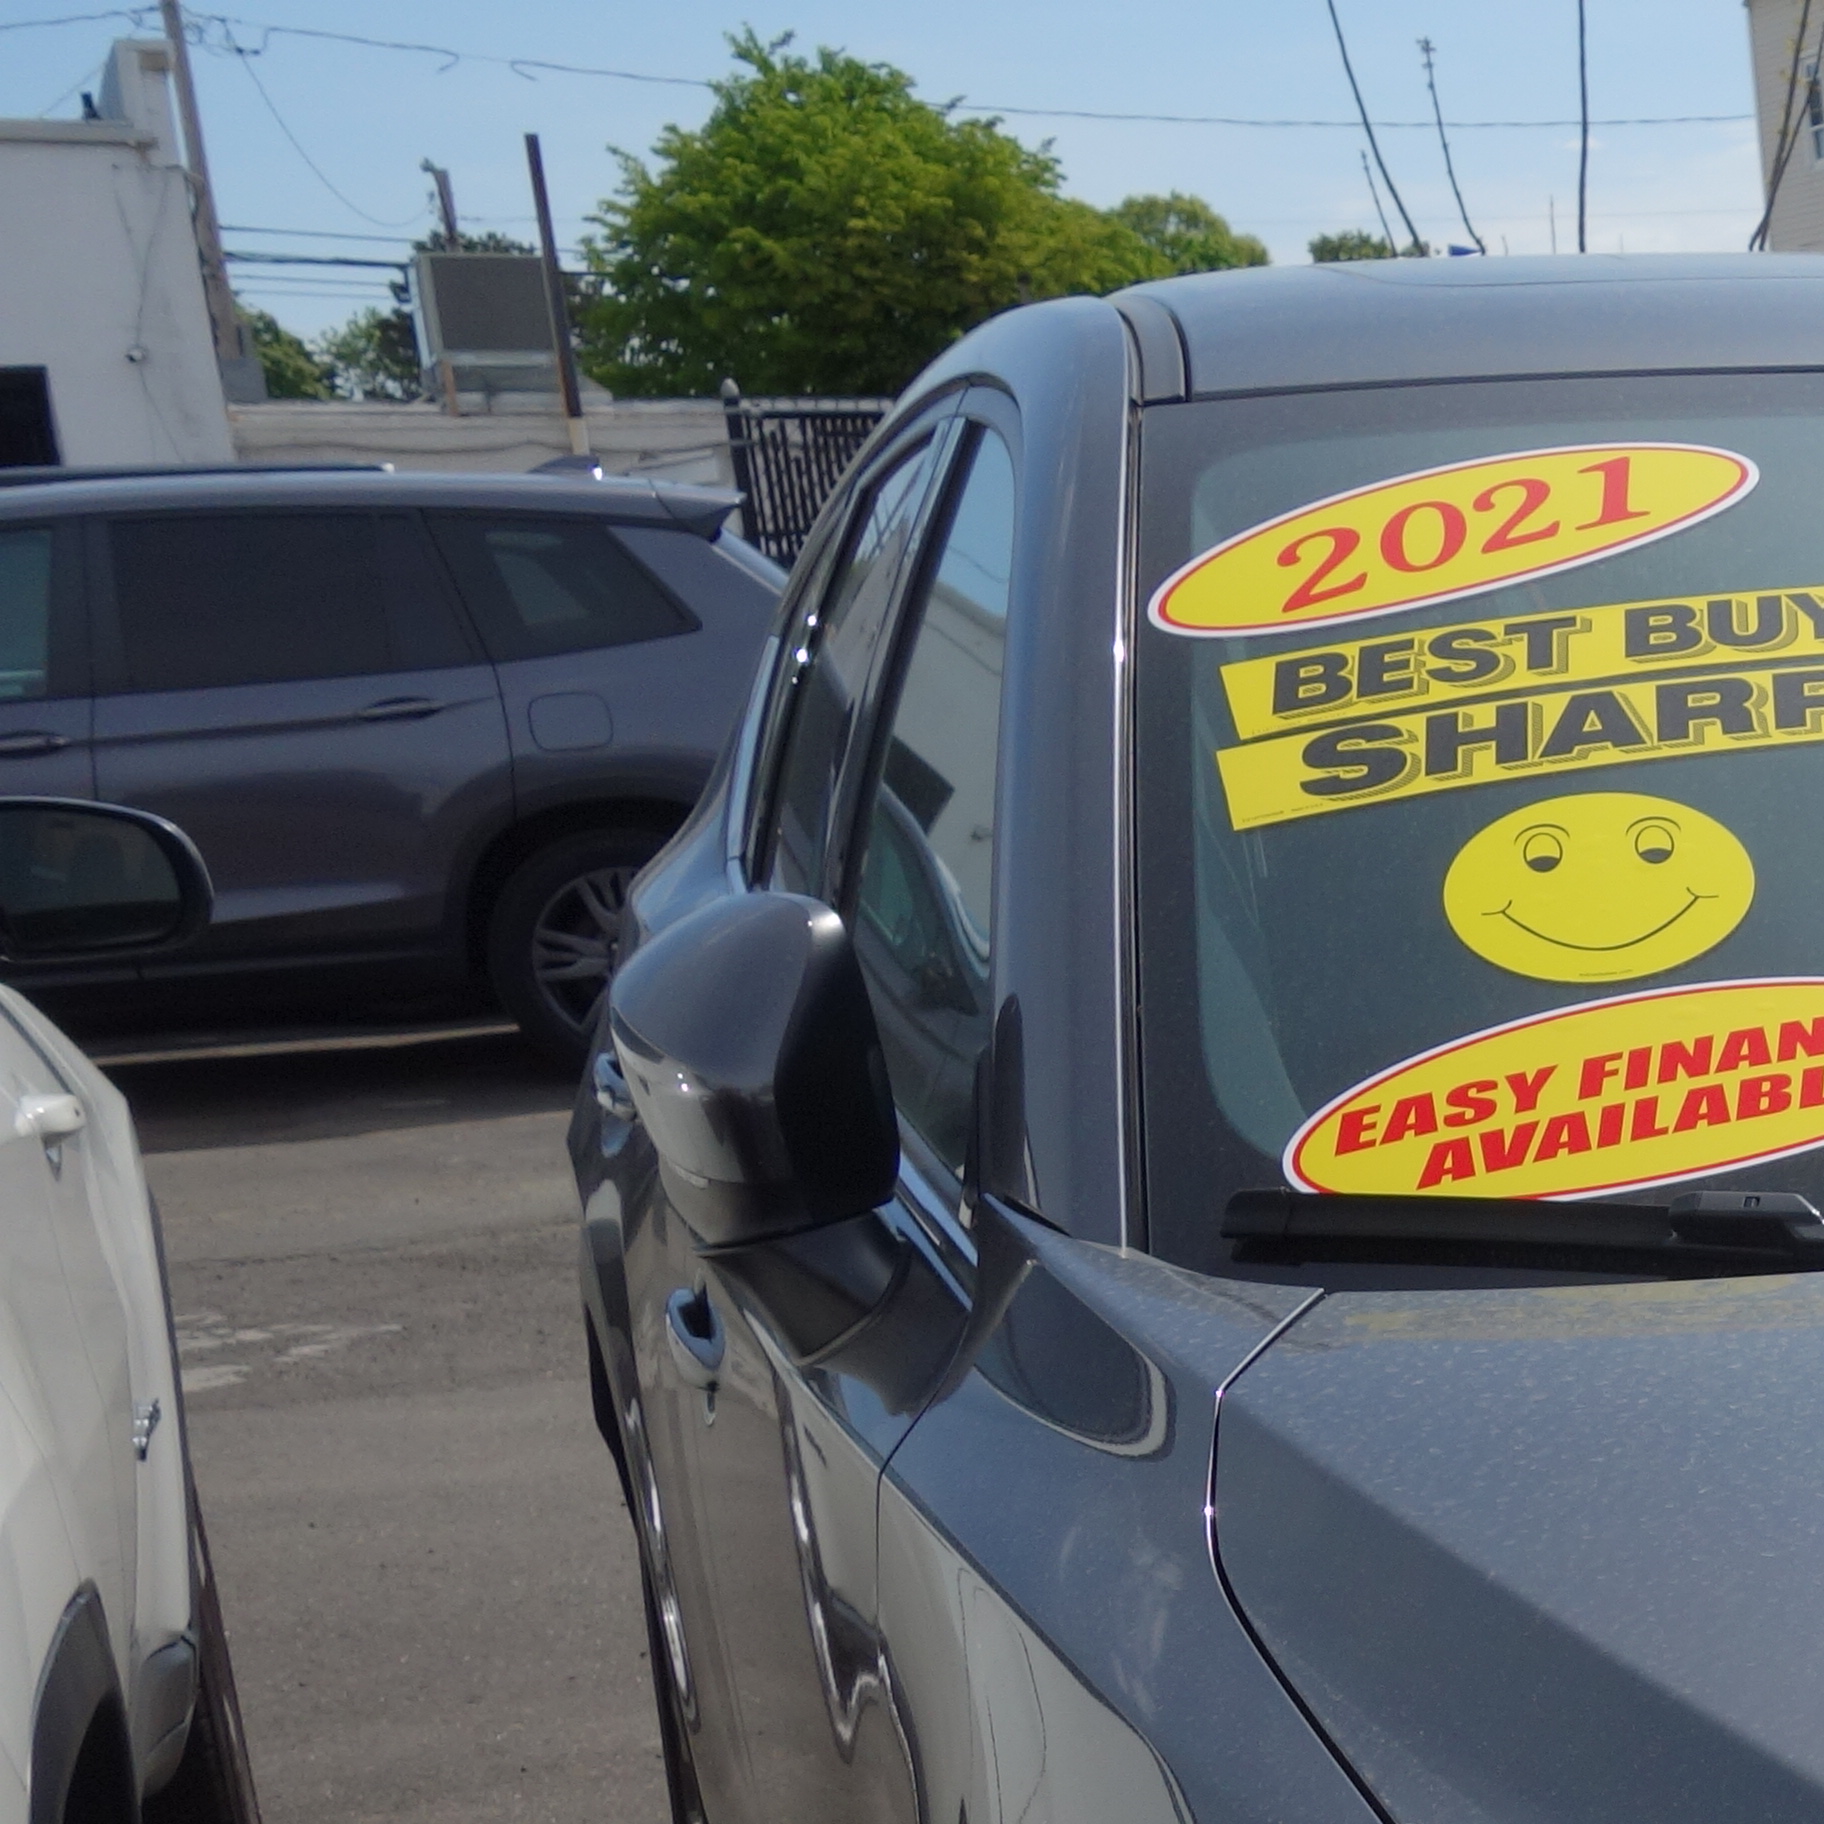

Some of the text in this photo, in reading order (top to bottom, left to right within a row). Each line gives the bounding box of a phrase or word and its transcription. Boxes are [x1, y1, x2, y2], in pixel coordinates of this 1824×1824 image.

[1277, 455, 1651, 612] 2021
[1271, 614, 1591, 718] BEST
[1335, 1065, 1558, 1156] EASY
